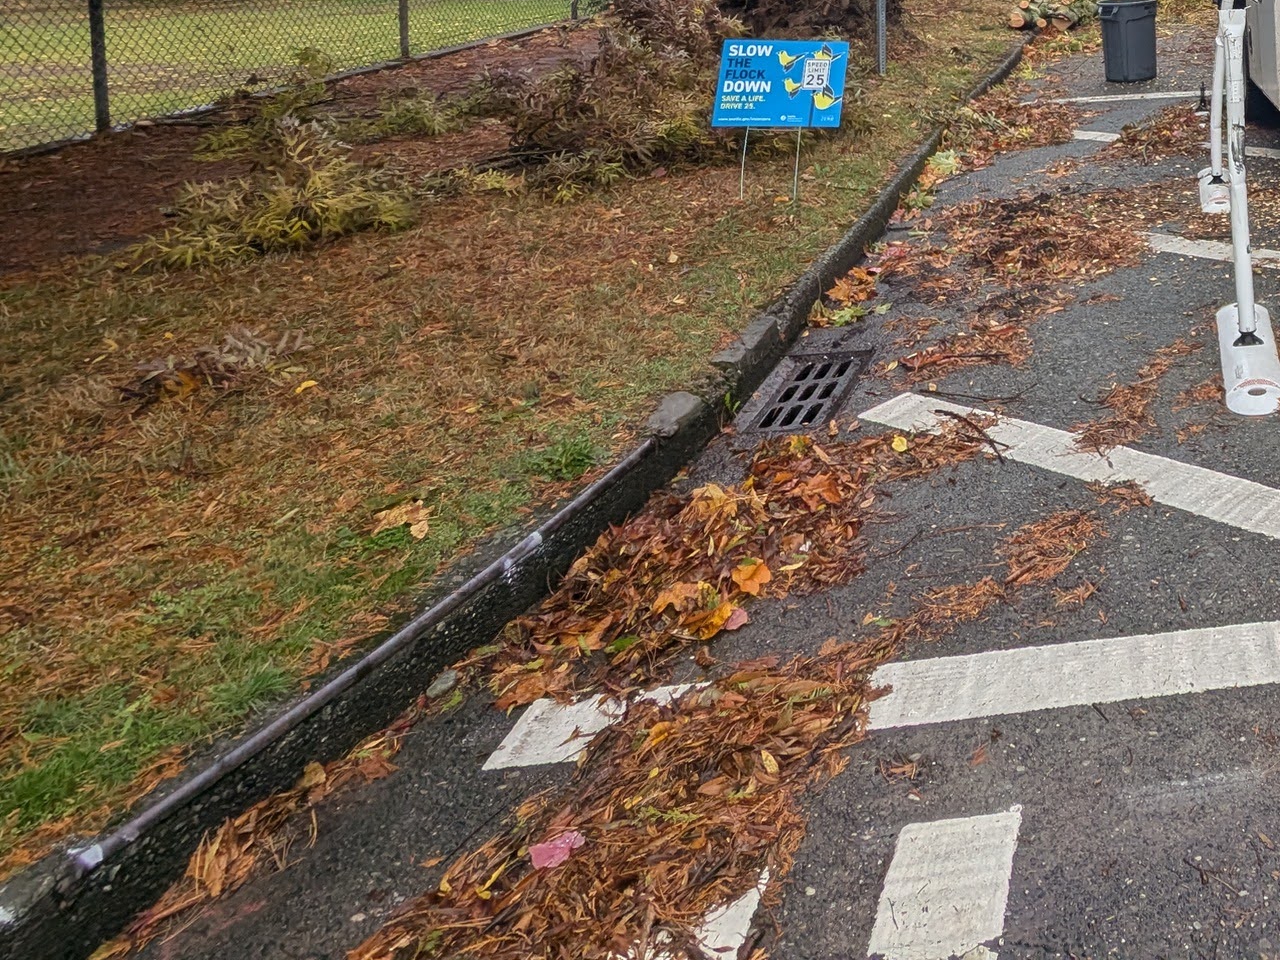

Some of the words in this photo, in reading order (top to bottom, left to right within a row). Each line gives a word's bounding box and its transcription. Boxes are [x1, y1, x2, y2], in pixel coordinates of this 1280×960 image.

[728, 44, 773, 57] SLOW
[727, 58, 752, 69] THE
[725, 69, 766, 80] FLOCK
[805, 74, 825, 86] 25
[723, 80, 771, 93] DOWN
[720, 102, 743, 110] DRIVE
